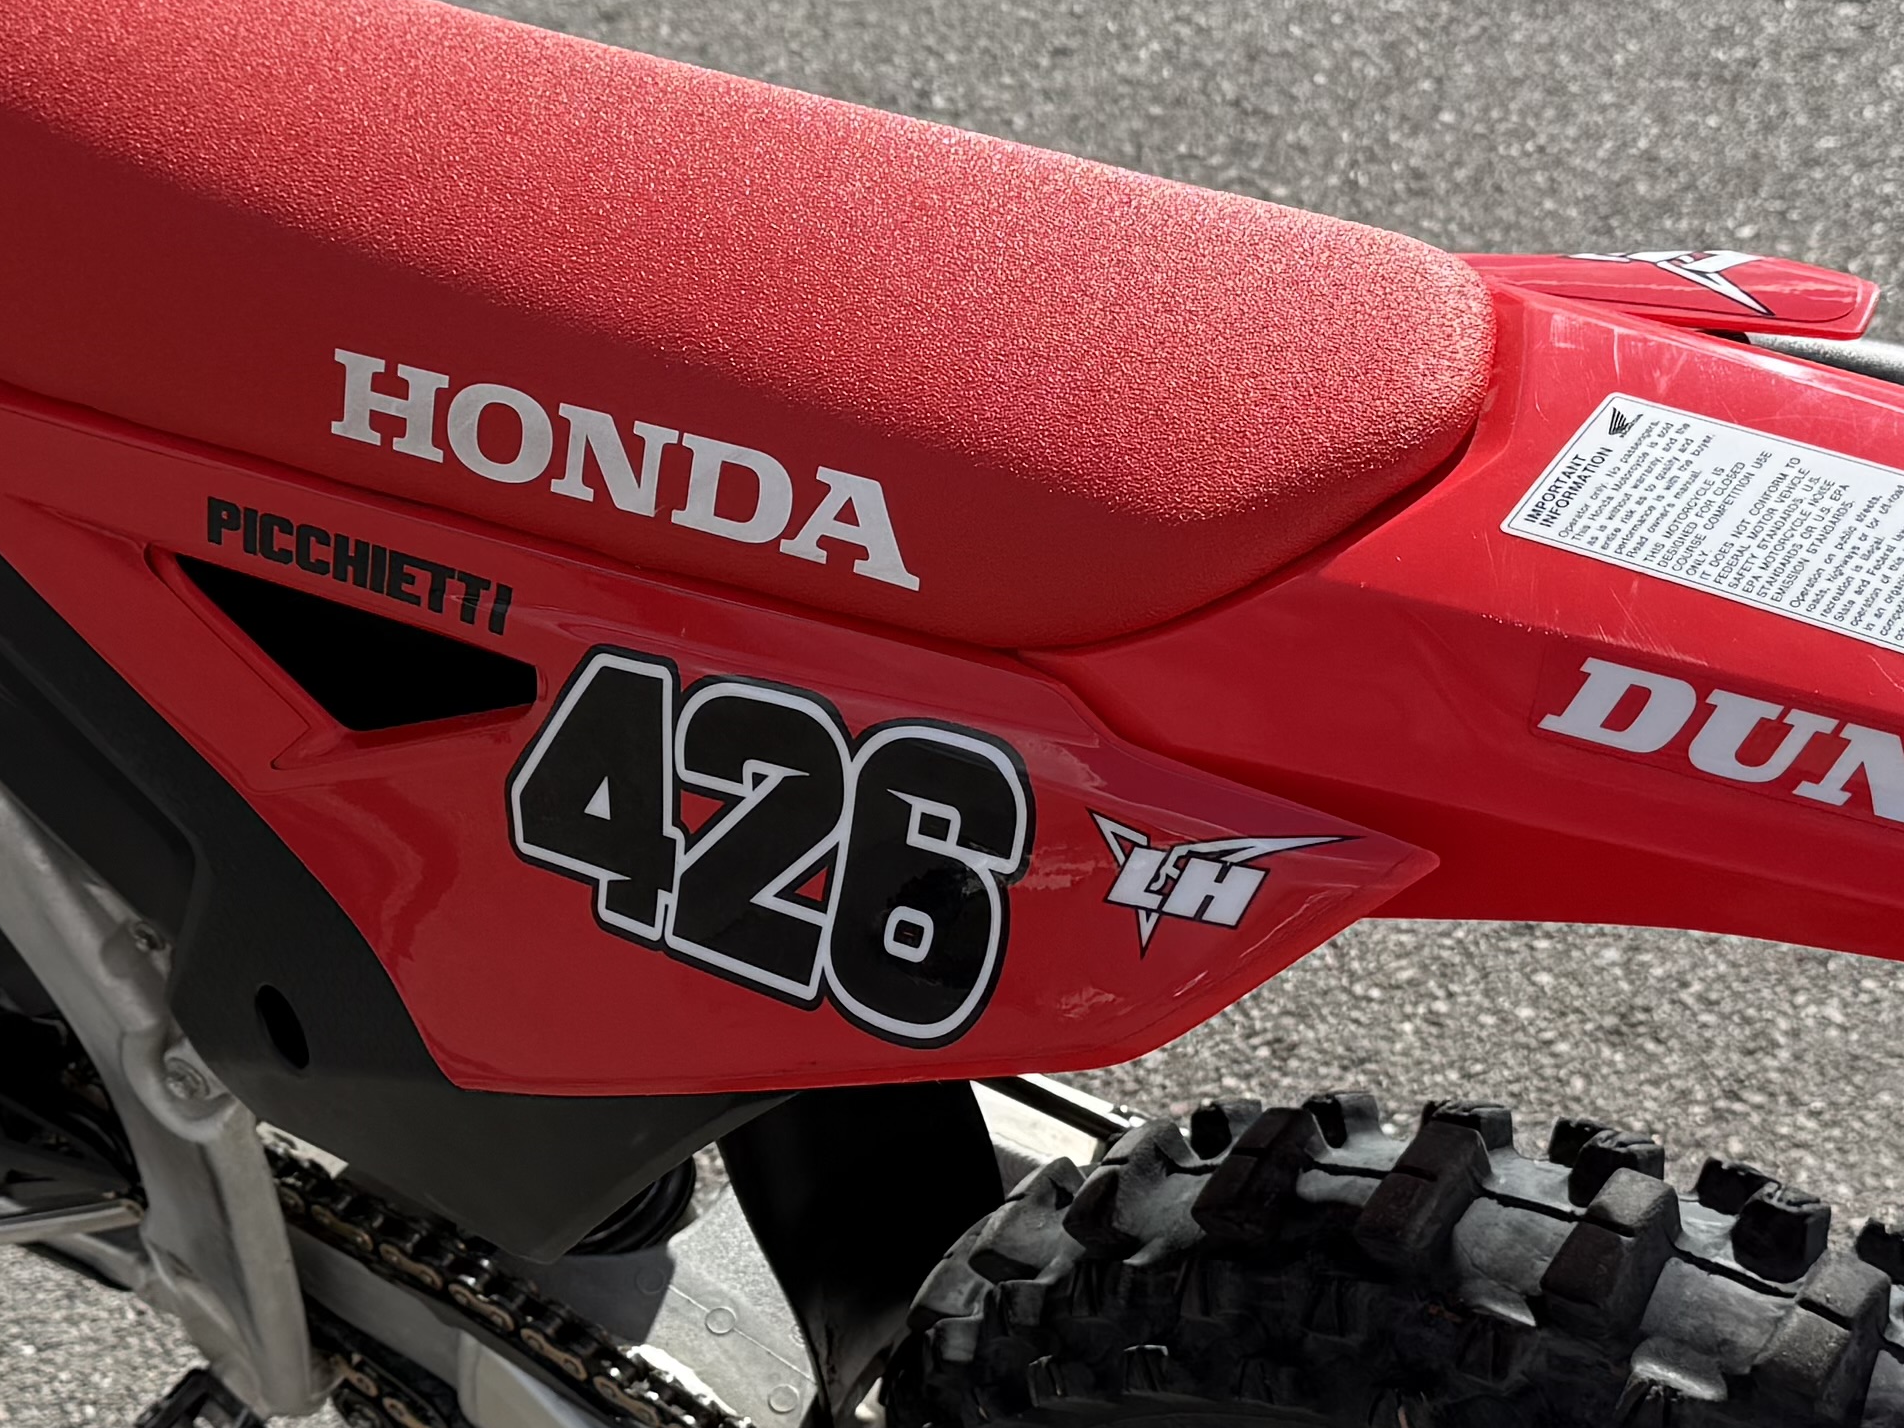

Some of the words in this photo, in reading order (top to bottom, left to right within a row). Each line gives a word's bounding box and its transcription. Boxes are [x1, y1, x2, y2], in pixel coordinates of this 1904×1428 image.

[330, 347, 921, 592] HONDA
[1524, 454, 1587, 524] IMPORTANT
[1539, 446, 1614, 528] INFORMATION
[1642, 541, 1666, 563] THIS
[1661, 478, 1716, 540] MOTORCYCLE
[1711, 466, 1725, 477] IS
[1656, 521, 1699, 568] DESIGNED
[1694, 499, 1716, 519] FOR
[1712, 461, 1746, 497] CLOSED
[1671, 533, 1707, 572] COURSE
[1702, 471, 1756, 531] COMPETITION
[1750, 450, 1773, 470] USE
[1699, 570, 1712, 581] IT
[1708, 541, 1735, 568] DOES
[1730, 518, 1751, 539] NOT
[1748, 472, 1790, 517] CONFORM
[1784, 457, 1801, 469] TO
[1712, 544, 1752, 585] FEDERAL
[1746, 507, 1779, 541] MOTOR
[1773, 467, 1811, 504] VEHICLE
[206, 496, 515, 637] PICCHIETTI
[1727, 552, 1760, 590] SAFETY
[1741, 575, 1763, 594] EPA
[1757, 509, 1813, 572] MOTORCYCLE
[1807, 479, 1836, 508] NOISE
[1755, 542, 1804, 598] STANDARDS
[1799, 525, 1818, 540] OR
[1829, 484, 1851, 502] EPA
[1769, 557, 1811, 603] EMISSION
[1805, 500, 1856, 555] STANDARDS.
[507, 646, 1033, 1048] 426
